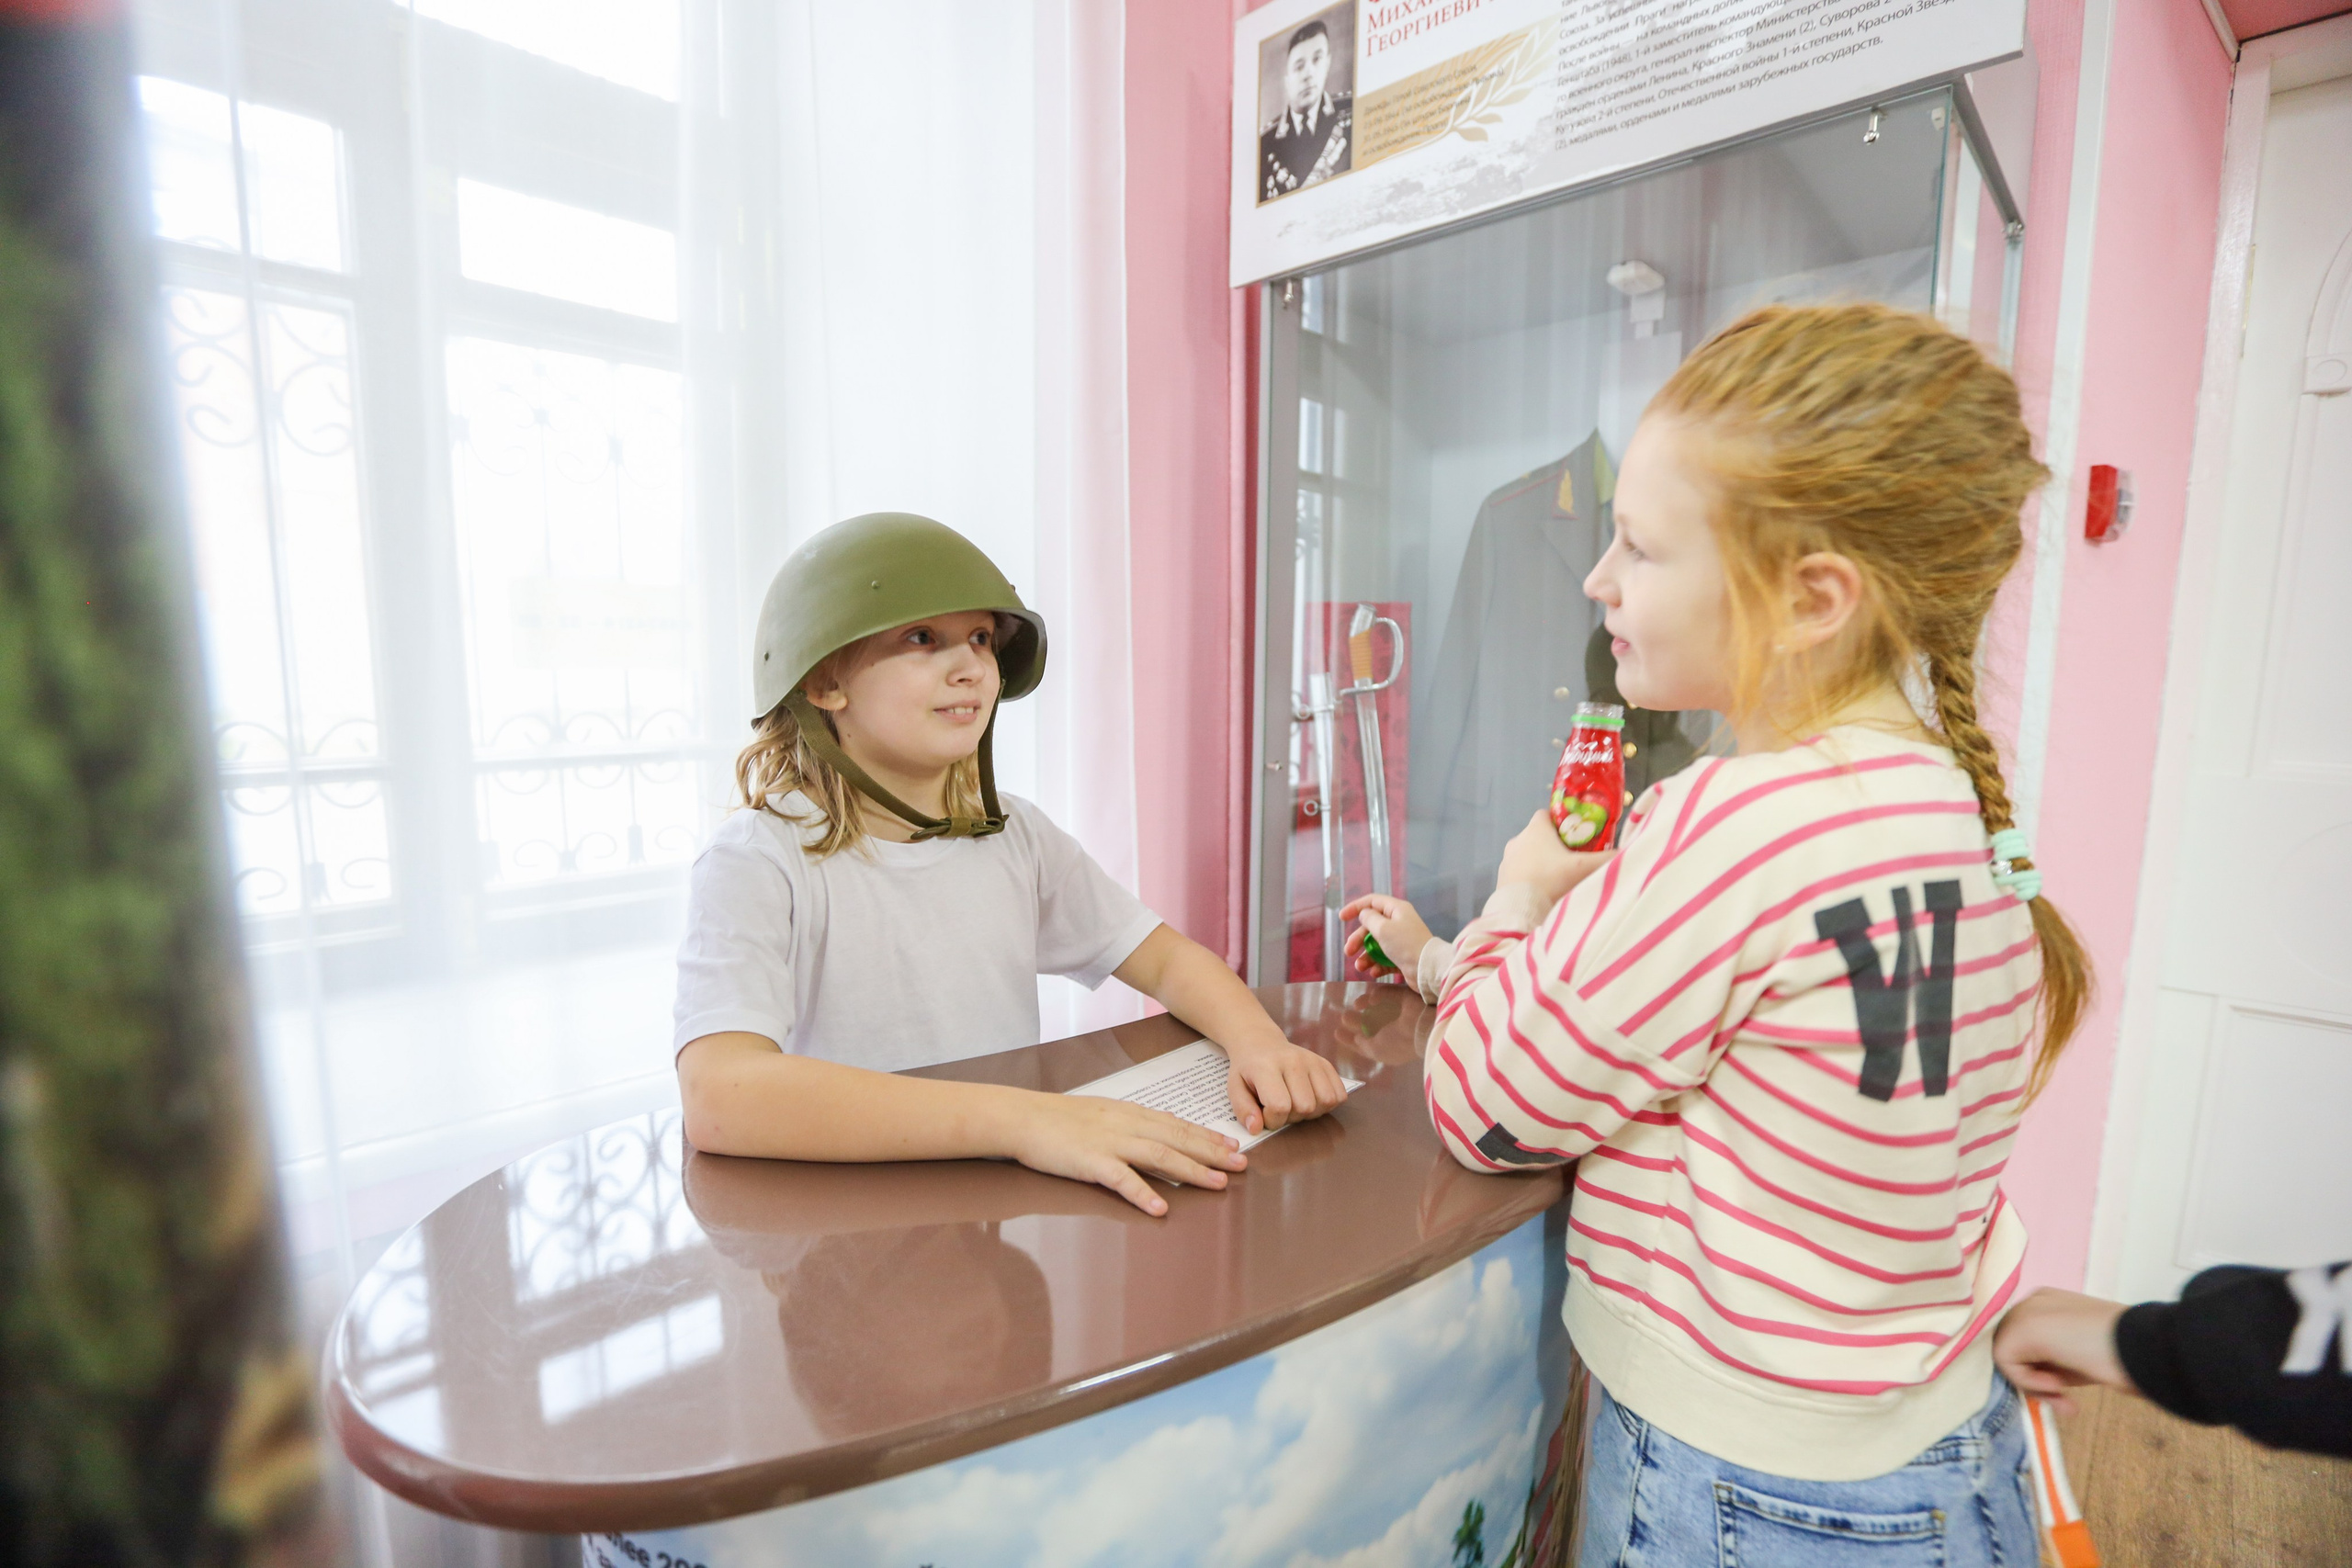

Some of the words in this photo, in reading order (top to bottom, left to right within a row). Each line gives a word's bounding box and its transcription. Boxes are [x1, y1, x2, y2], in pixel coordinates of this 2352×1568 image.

[1366, 0, 1481, 57] ГЕОРГИЕВИ
[1367, 0, 1441, 34] МИХА
[1650, 9, 1710, 36] командных
[1653, 24, 1717, 52] заместитель
[1719, 0, 1789, 28] командующ
[1692, 47, 1744, 72] Красного
[1747, 27, 1796, 52] Знамени
[1799, 20, 1817, 36] (2),
[1819, 0, 1881, 28] Суворова
[1651, 25, 1754, 70] генерал-инспектор
[1657, 64, 1740, 100] Отечественной
[1742, 51, 1780, 72] войны
[1782, 42, 1801, 58] 1-й
[1802, 26, 1855, 51] степени,
[1857, 4, 1914, 33] Красной
[1620, 107, 1671, 130] орденами
[1681, 84, 1736, 109] медалями
[1738, 57, 1809, 92] зарубежных
[1811, 36, 1883, 65] государств.
